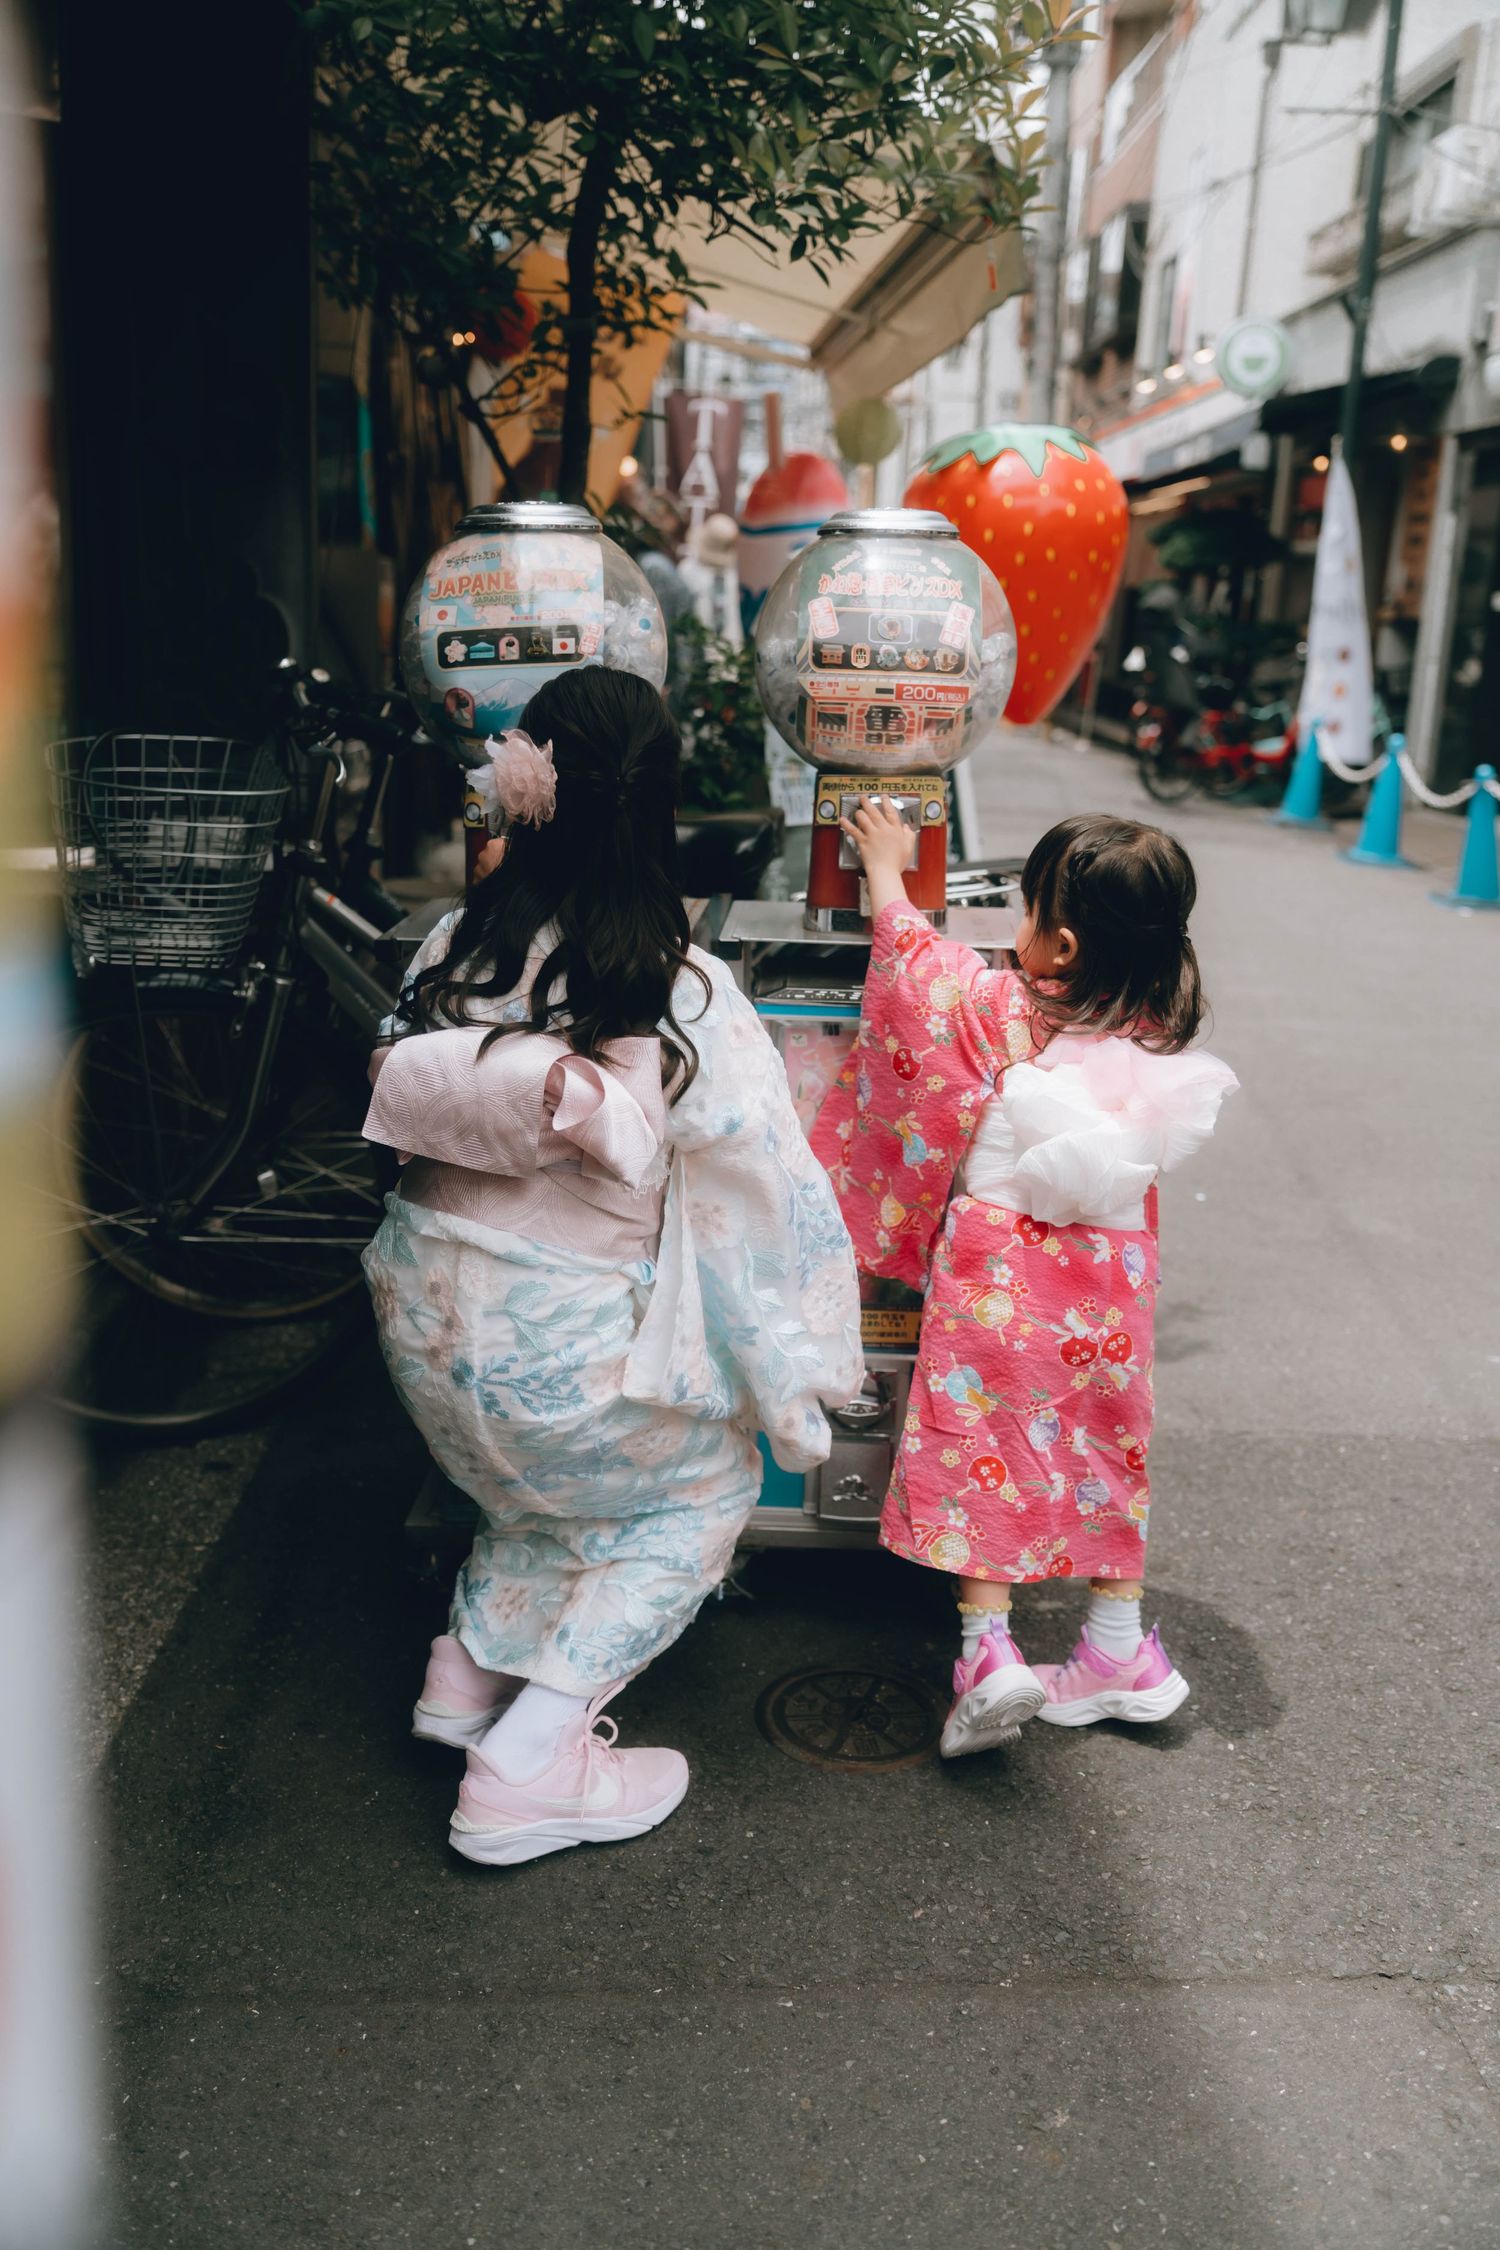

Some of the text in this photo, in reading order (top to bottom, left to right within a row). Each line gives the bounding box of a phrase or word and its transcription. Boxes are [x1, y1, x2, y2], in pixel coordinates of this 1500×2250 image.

[857, 783, 879, 791] 100
[881, 783, 938, 792] 円玉を入れてね
